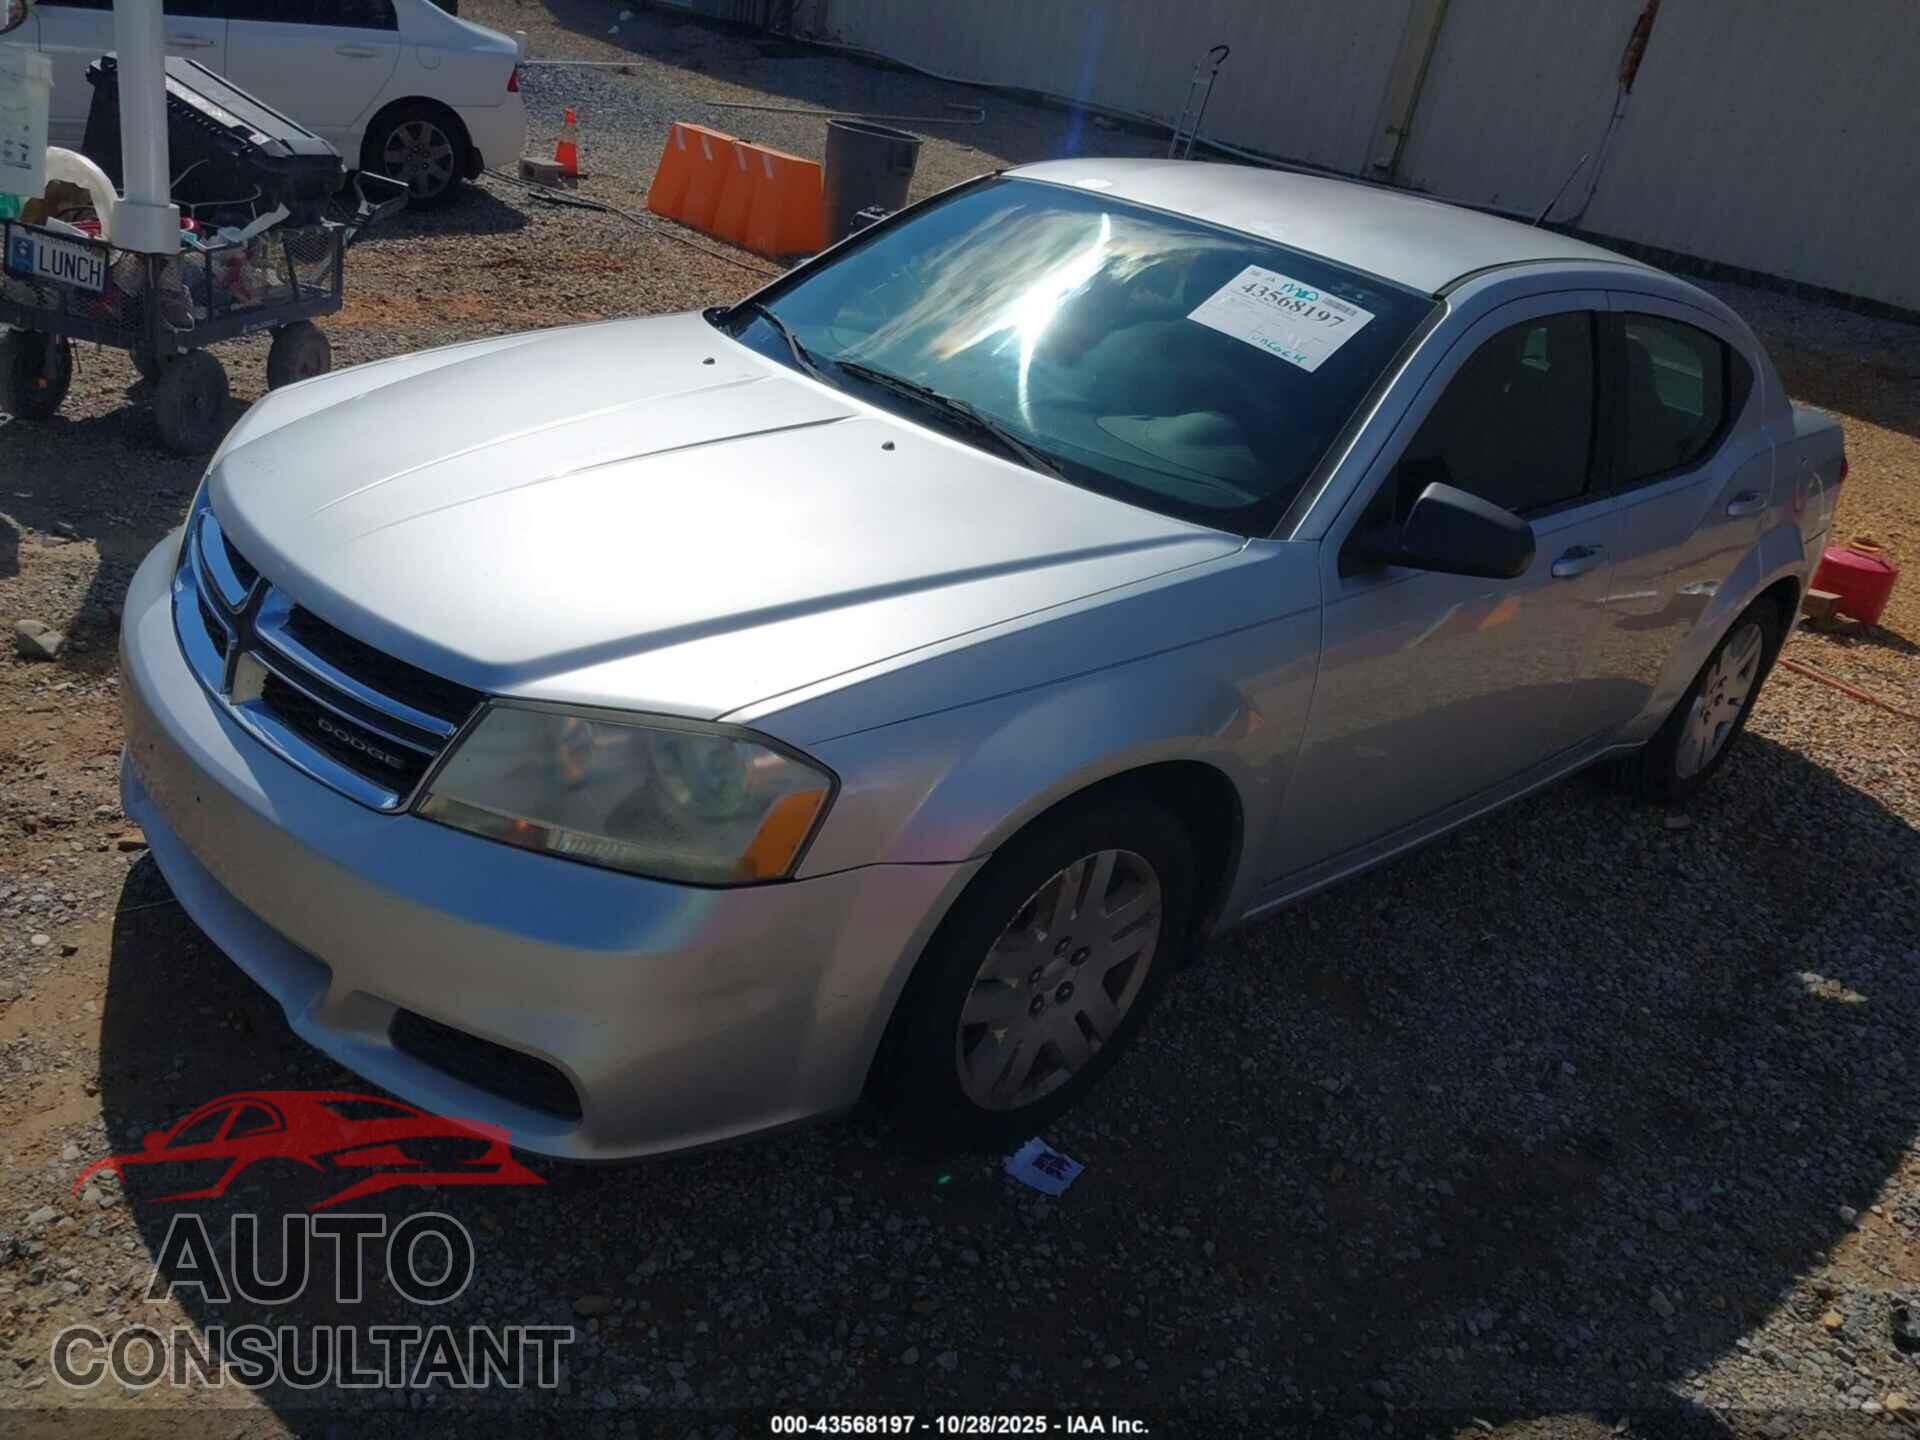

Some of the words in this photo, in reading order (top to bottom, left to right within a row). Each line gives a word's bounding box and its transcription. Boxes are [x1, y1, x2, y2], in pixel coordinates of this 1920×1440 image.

[39, 244, 102, 287] LUNCH
[1241, 282, 1345, 328] 43568197
[317, 718, 404, 770] DODGE
